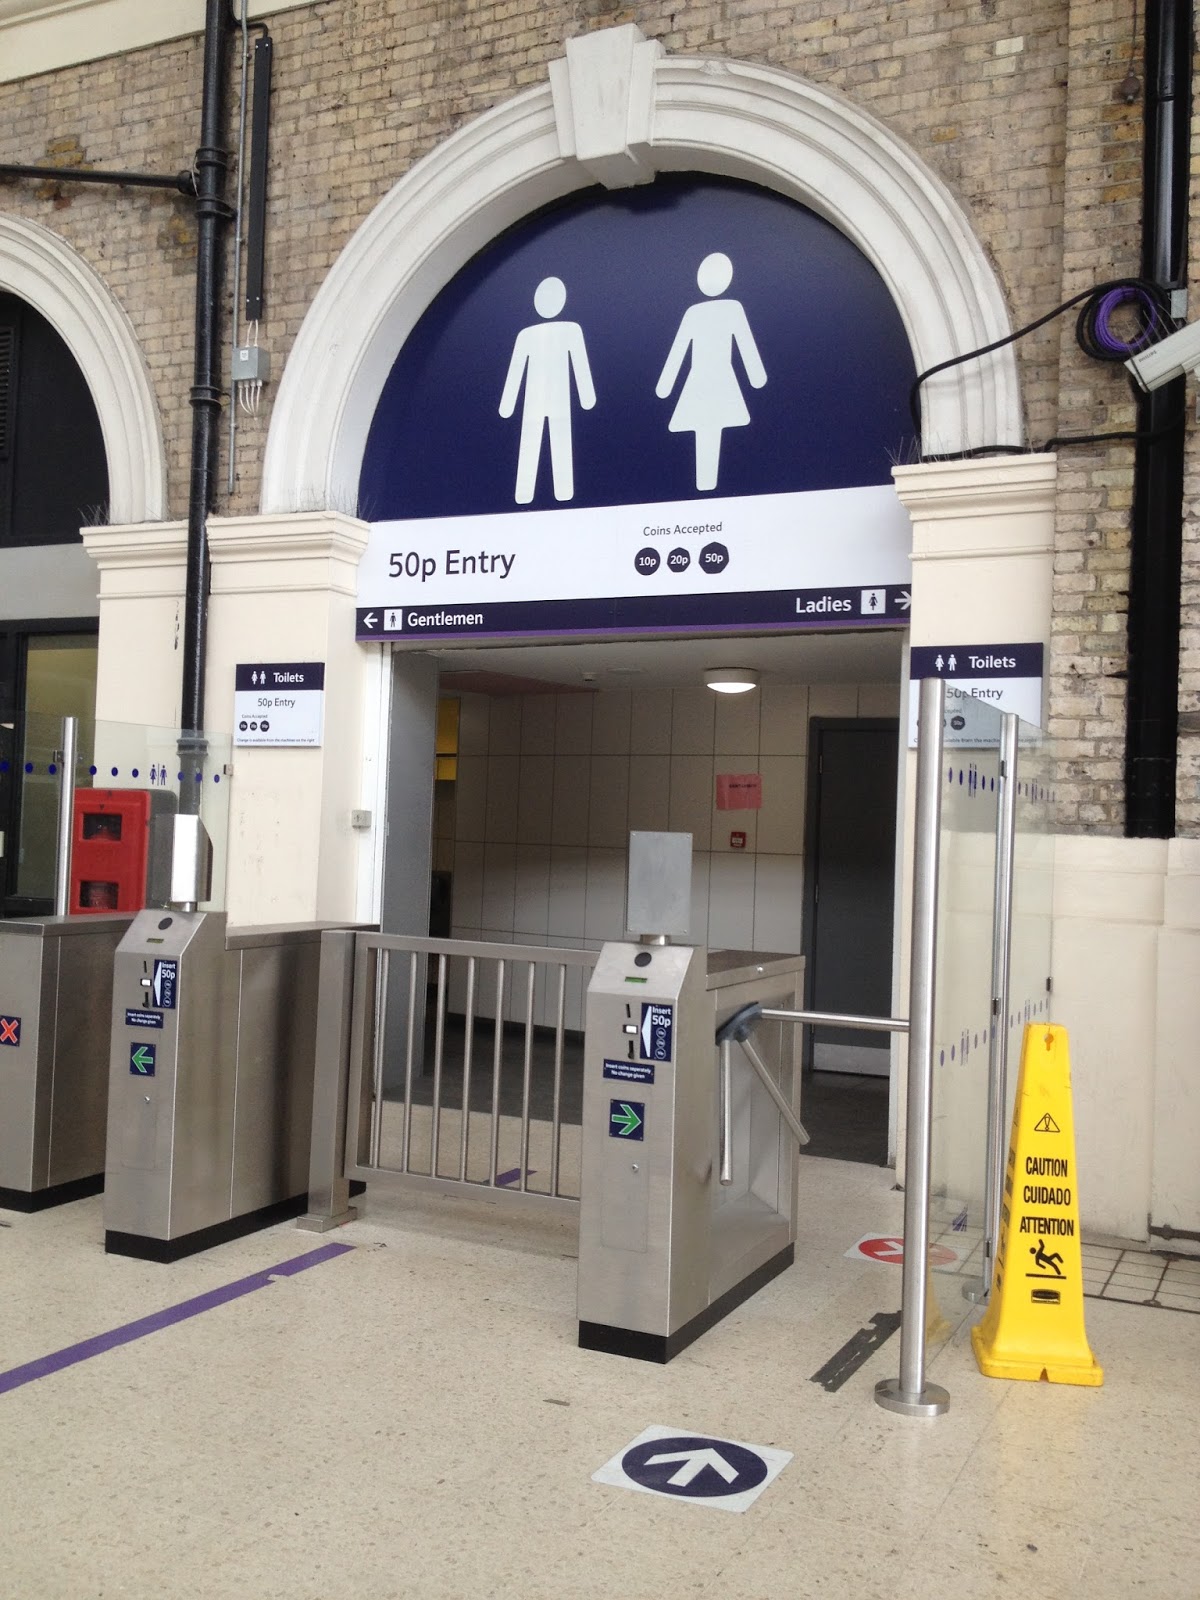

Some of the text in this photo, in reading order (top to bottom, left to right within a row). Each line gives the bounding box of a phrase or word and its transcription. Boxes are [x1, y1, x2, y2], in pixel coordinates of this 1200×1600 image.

[643, 521, 723, 537] Coins Accepted
[389, 549, 516, 582] 50p Entry
[639, 552, 724, 567] 10p 20p 50p
[796, 596, 852, 613] Ladies
[407, 610, 484, 627] Gentlemen
[968, 655, 1016, 669] Toilets
[273, 672, 305, 683] Toilets
[946, 687, 1003, 700] 50p Entry
[258, 697, 296, 708] 50p Entry
[161, 969, 175, 980] 50p
[652, 1006, 671, 1015] Insert
[652, 1014, 671, 1028] 50p
[618, 1070, 632, 1078] change
[1025, 1156, 1068, 1177] CAUTION
[1023, 1185, 1071, 1206] CUIDADO
[1020, 1216, 1074, 1236] ATTENTION
